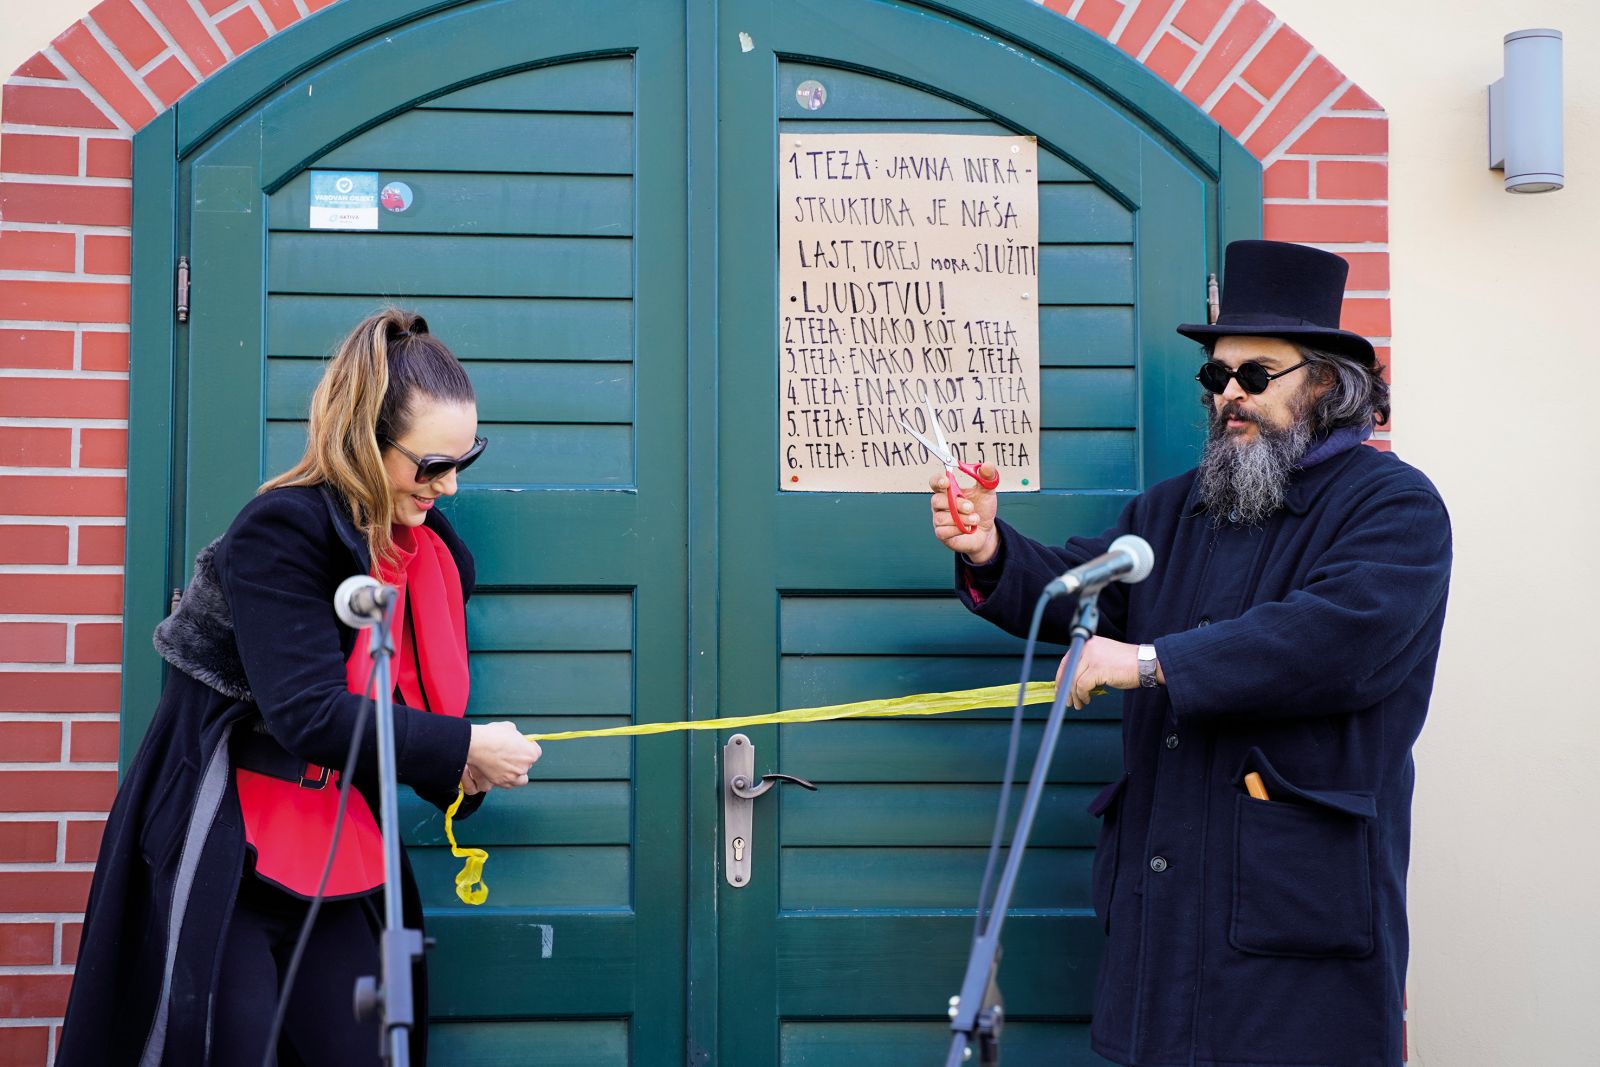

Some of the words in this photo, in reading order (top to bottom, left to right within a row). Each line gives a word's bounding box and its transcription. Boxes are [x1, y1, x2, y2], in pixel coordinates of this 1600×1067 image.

[886, 156, 954, 182] JAVNA
[794, 196, 915, 228] STRUKTURA
[927, 198, 949, 226] JE
[961, 195, 1018, 229] NAŠA
[798, 240, 856, 273] LAST,
[860, 240, 920, 271] TOREJ
[931, 258, 970, 276] MORA
[975, 238, 1036, 276] SLUŽITI
[802, 280, 946, 315] LJUDSTVU!
[850, 316, 916, 345] ENAKO
[923, 318, 957, 345] KOT
[849, 347, 914, 375] ENAKO
[922, 347, 953, 374] KOT
[854, 377, 928, 406] ENAKO
[933, 376, 966, 404] KOT
[857, 407, 927, 436] ENAKO
[934, 408, 966, 434] KOT
[861, 441, 929, 469] ENAKO
